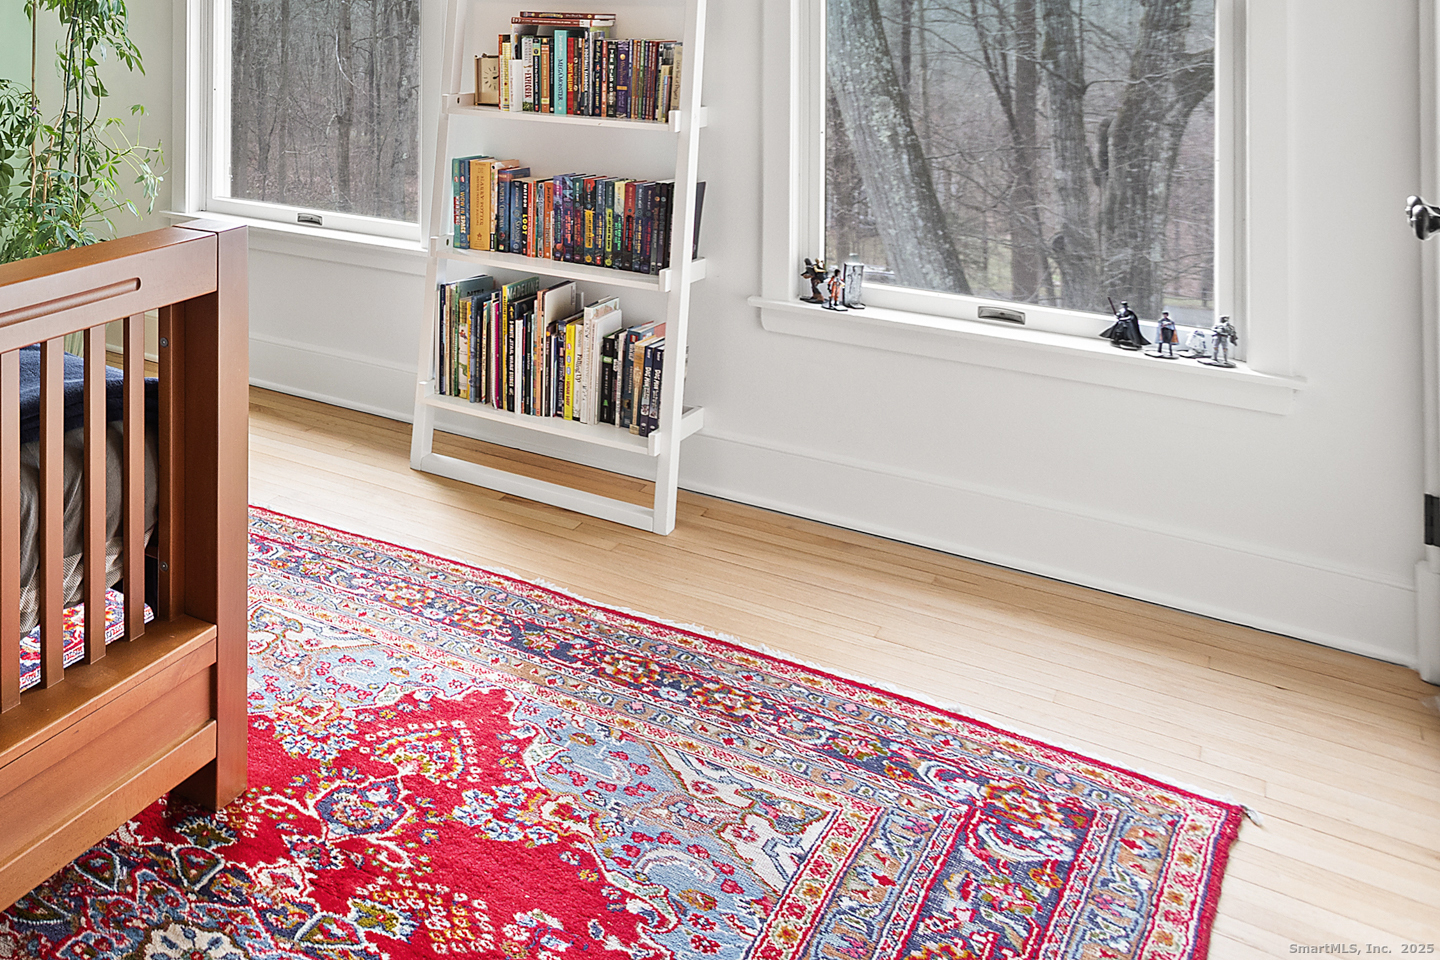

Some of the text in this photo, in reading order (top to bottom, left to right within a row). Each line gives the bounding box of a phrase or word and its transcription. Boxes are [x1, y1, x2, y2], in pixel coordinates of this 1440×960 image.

[524, 72, 532, 99] EXPLORER
[513, 220, 522, 243] SKANDAR
[508, 279, 540, 300] MADELINE
[574, 353, 583, 383] Falling Up
[653, 369, 661, 380] DOG
